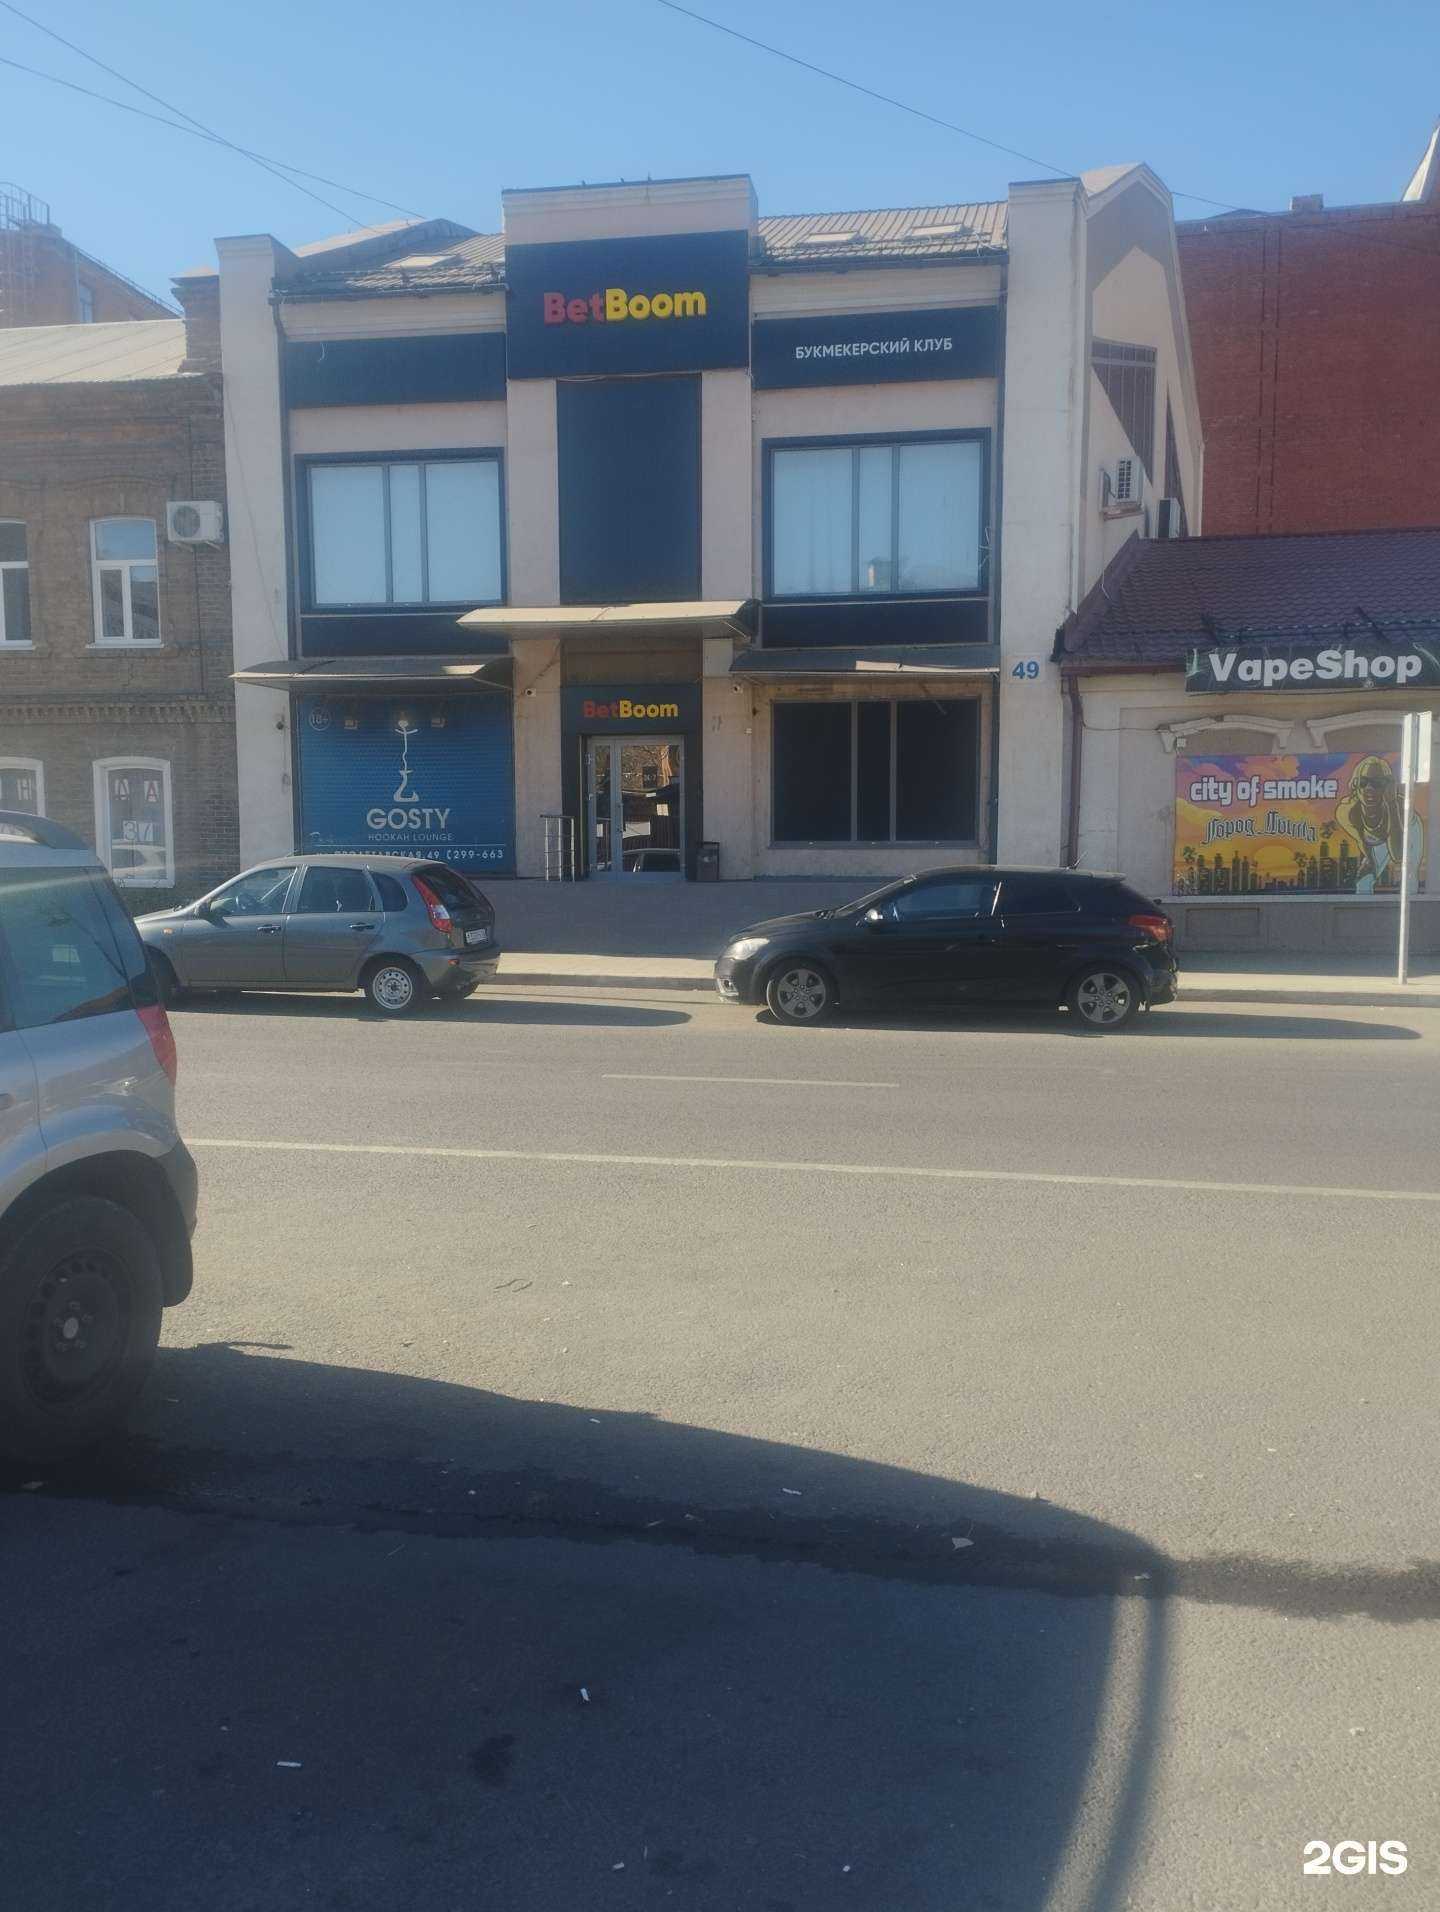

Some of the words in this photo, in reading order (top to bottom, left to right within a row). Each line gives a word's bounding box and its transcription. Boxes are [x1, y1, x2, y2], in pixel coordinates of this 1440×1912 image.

[543, 287, 707, 325] BetBoom
[795, 337, 910, 360] БУКМЕКЕРСКИЙ
[914, 337, 953, 353] КЛУБ
[1012, 661, 1039, 679] 49
[1208, 649, 1423, 687] VapeShop
[583, 699, 679, 718] BetBoom
[1190, 776, 1232, 807] city
[1237, 775, 1260, 808] of
[1263, 774, 1338, 801] smoke
[366, 808, 450, 830] GOSTY
[368, 832, 409, 842] HOOKAH
[413, 832, 454, 841] LOUNGE
